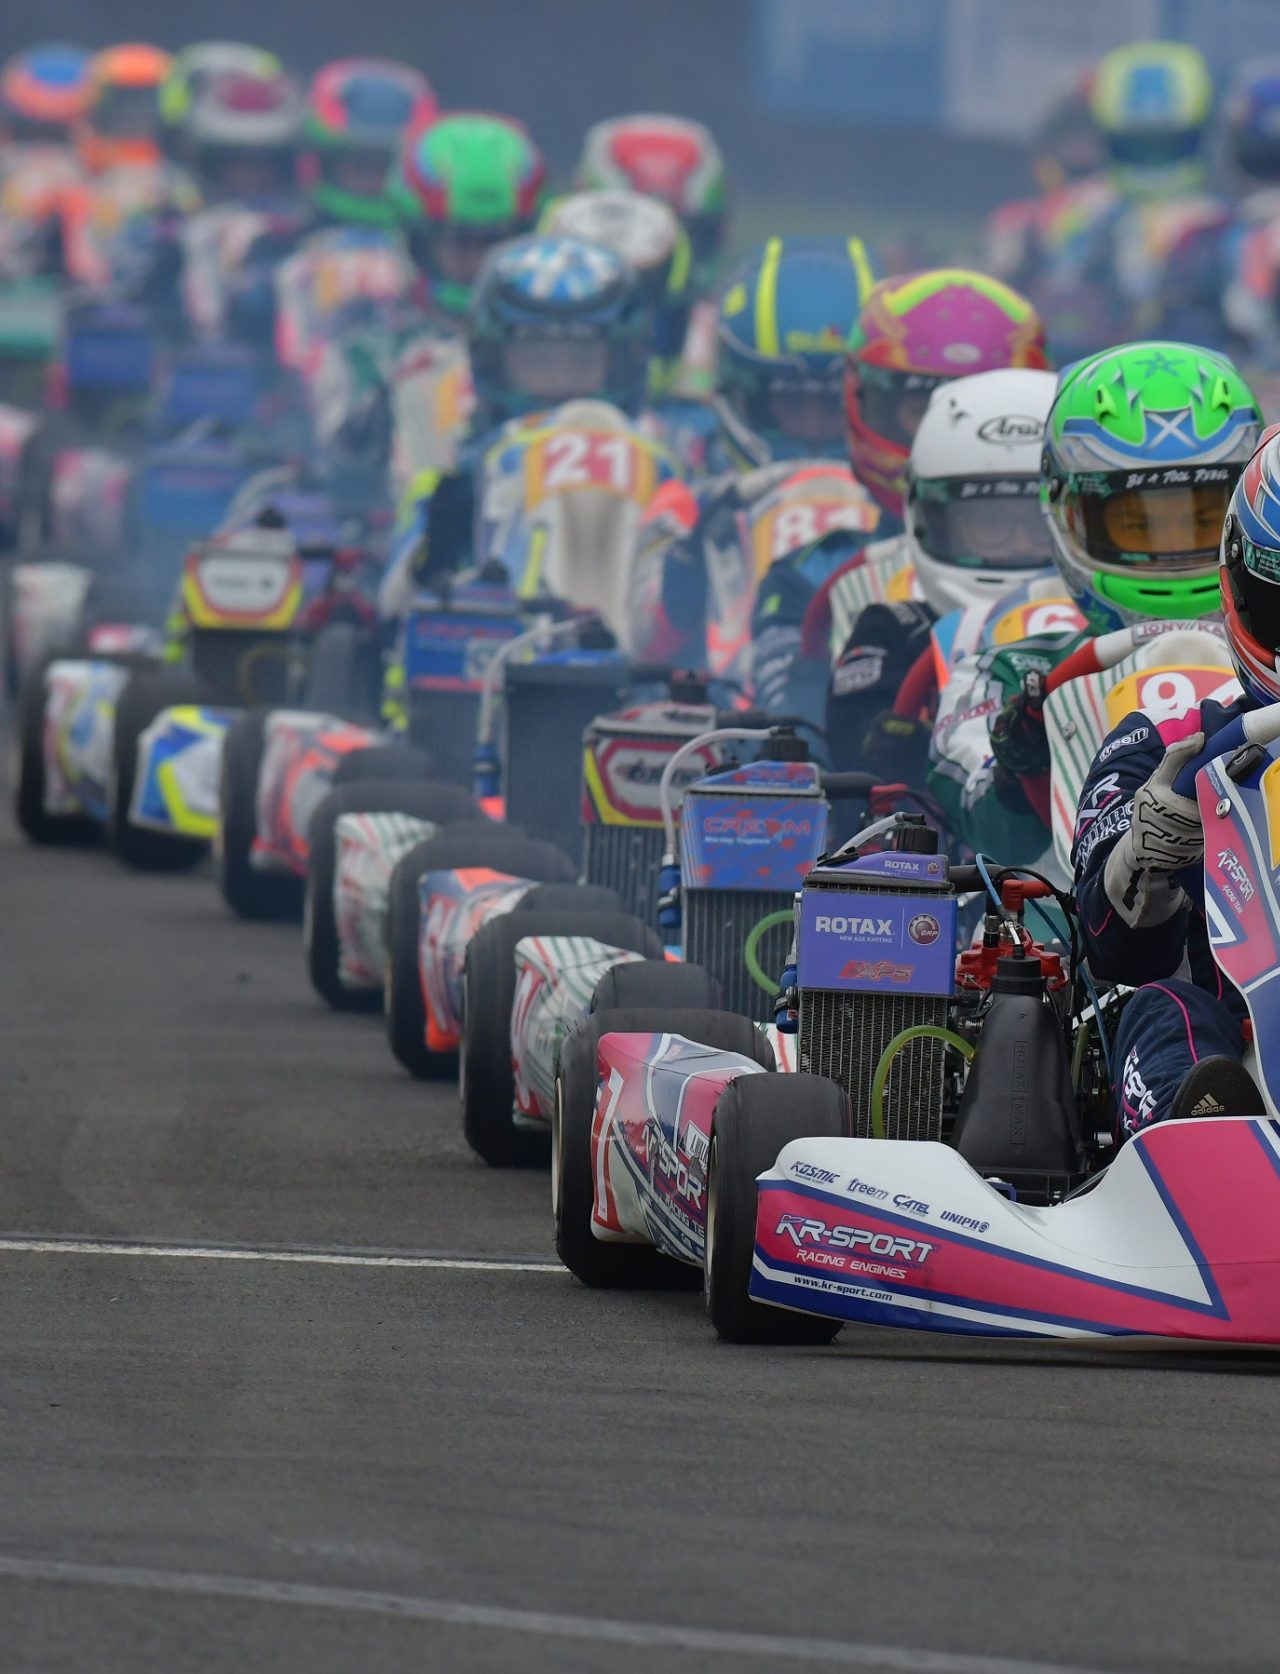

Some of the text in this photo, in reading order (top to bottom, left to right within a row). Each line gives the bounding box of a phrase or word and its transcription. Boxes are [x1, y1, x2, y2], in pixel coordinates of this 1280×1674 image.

[546, 433, 633, 487] 21
[884, 860, 919, 871] ROTAX
[815, 916, 893, 936] ROTAX
[1191, 1105, 1225, 1116] adidas
[790, 1160, 841, 1184] KOSMIC
[848, 1178, 889, 1201] freem
[940, 1210, 990, 1233] UNIPRO
[775, 1214, 935, 1264] KR-SPORT
[796, 1249, 907, 1279] RACING ENGINES
[794, 1274, 893, 1301] www.kr-sport.com
